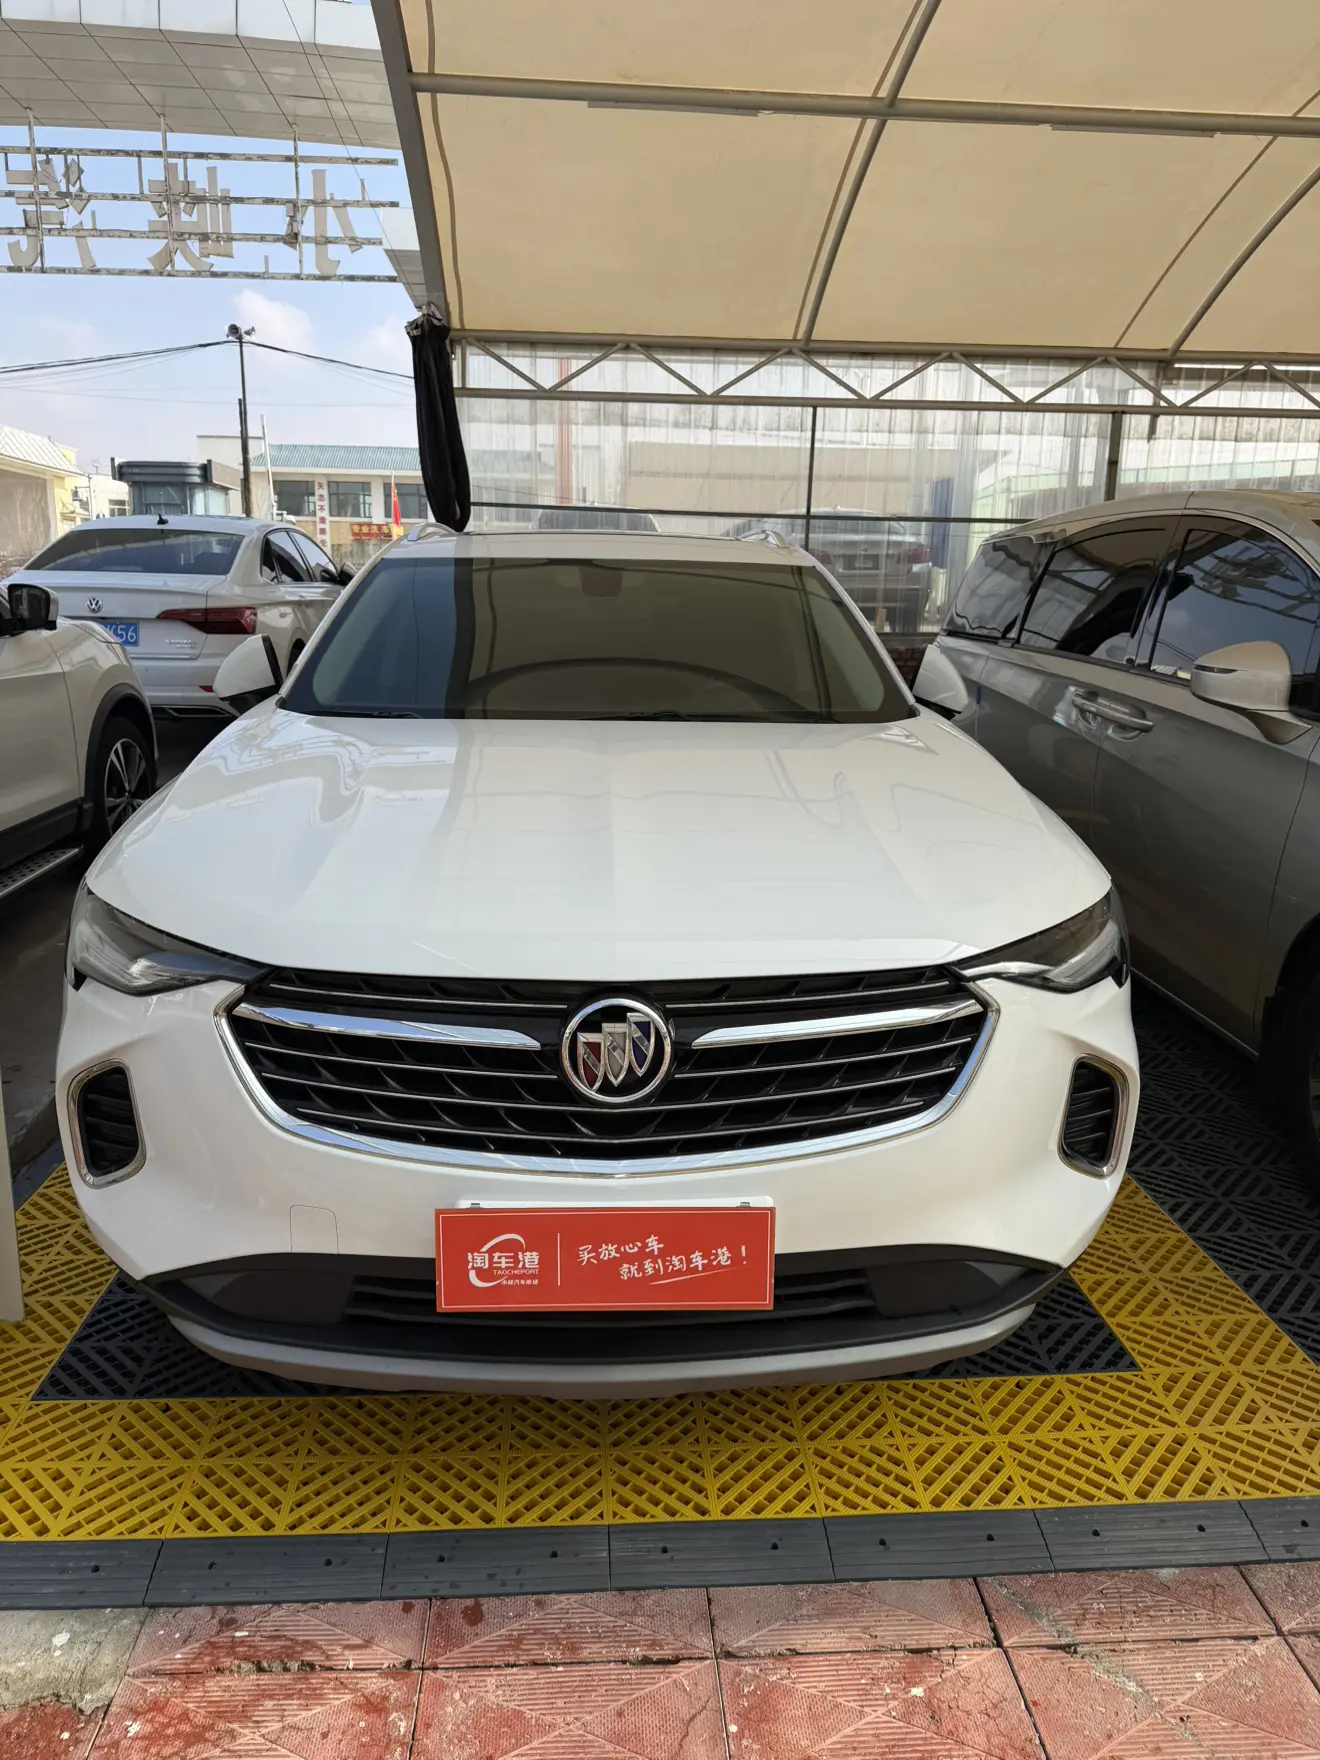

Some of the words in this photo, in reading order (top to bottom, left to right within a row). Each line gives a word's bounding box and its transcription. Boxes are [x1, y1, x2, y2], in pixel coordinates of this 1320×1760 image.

[577, 1234, 664, 1265] 买放心车
[467, 1251, 539, 1269] 淘车港
[493, 1268, 539, 1276] TAOCHEPORT
